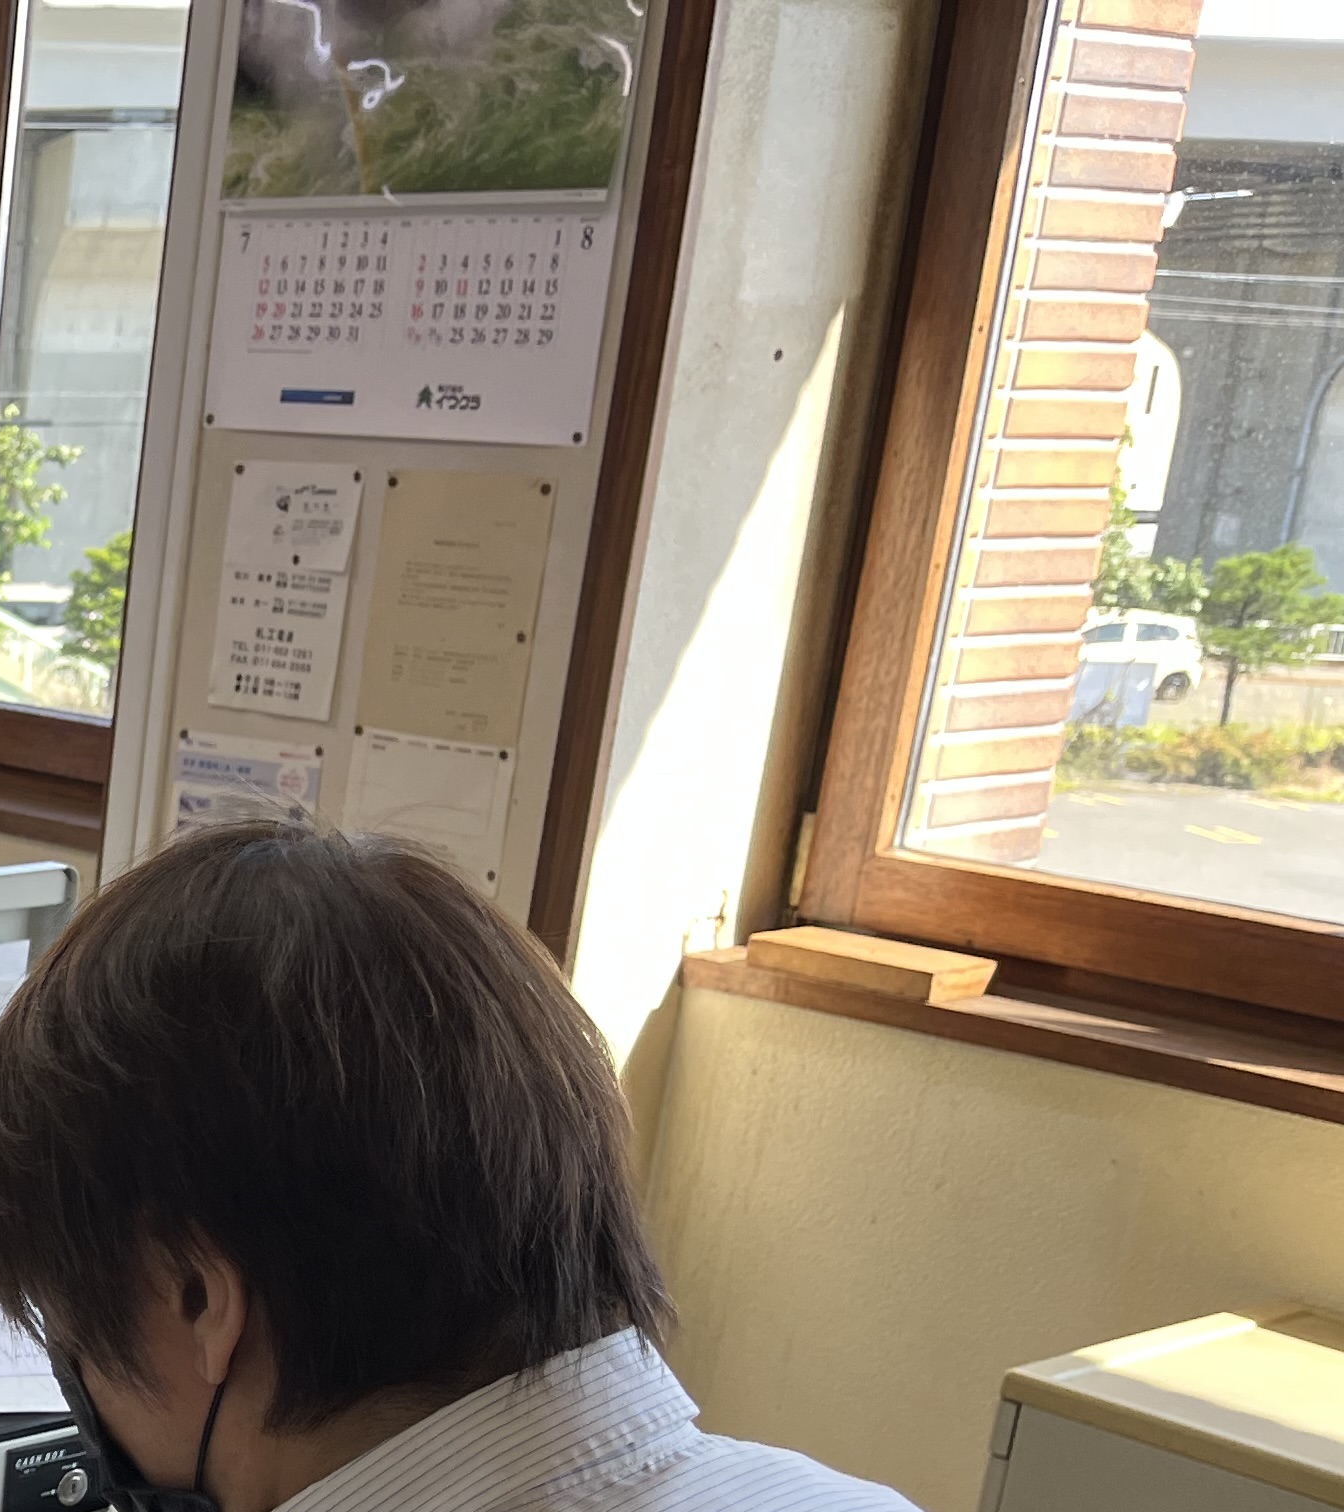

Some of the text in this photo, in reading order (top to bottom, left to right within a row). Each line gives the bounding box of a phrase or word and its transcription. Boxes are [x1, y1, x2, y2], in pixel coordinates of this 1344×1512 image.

[241, 231, 250, 254] 7
[322, 232, 328, 248] 1
[341, 231, 349, 248] 2
[381, 231, 388, 248] 4
[555, 230, 561, 246] 1
[580, 226, 594, 250] 8
[281, 255, 288, 273] 6
[300, 255, 307, 273] 7
[338, 255, 347, 271] 9
[356, 255, 369, 271] 10
[376, 255, 387, 271] 11
[419, 253, 559, 273] 2 3 4 5 6 7 8
[258, 278, 385, 296] 12 13 14 15 16 17 18
[416, 279, 558, 297] 9 10 11 12 13 14 15
[291, 303, 302, 318] 21
[309, 303, 323, 318] 22
[329, 302, 343, 318] 23
[349, 303, 363, 318] 24
[369, 302, 382, 318] 25
[412, 303, 555, 320] 16 17 18 19 20 21 22
[269, 325, 282, 341] 27
[287, 325, 301, 341] 28
[306, 325, 321, 341] 29
[326, 326, 341, 341] 30
[346, 325, 359, 342] 31
[449, 328, 553, 346] 25 26 27 28 29
[15, 1448, 67, 1469] CASH BOX
